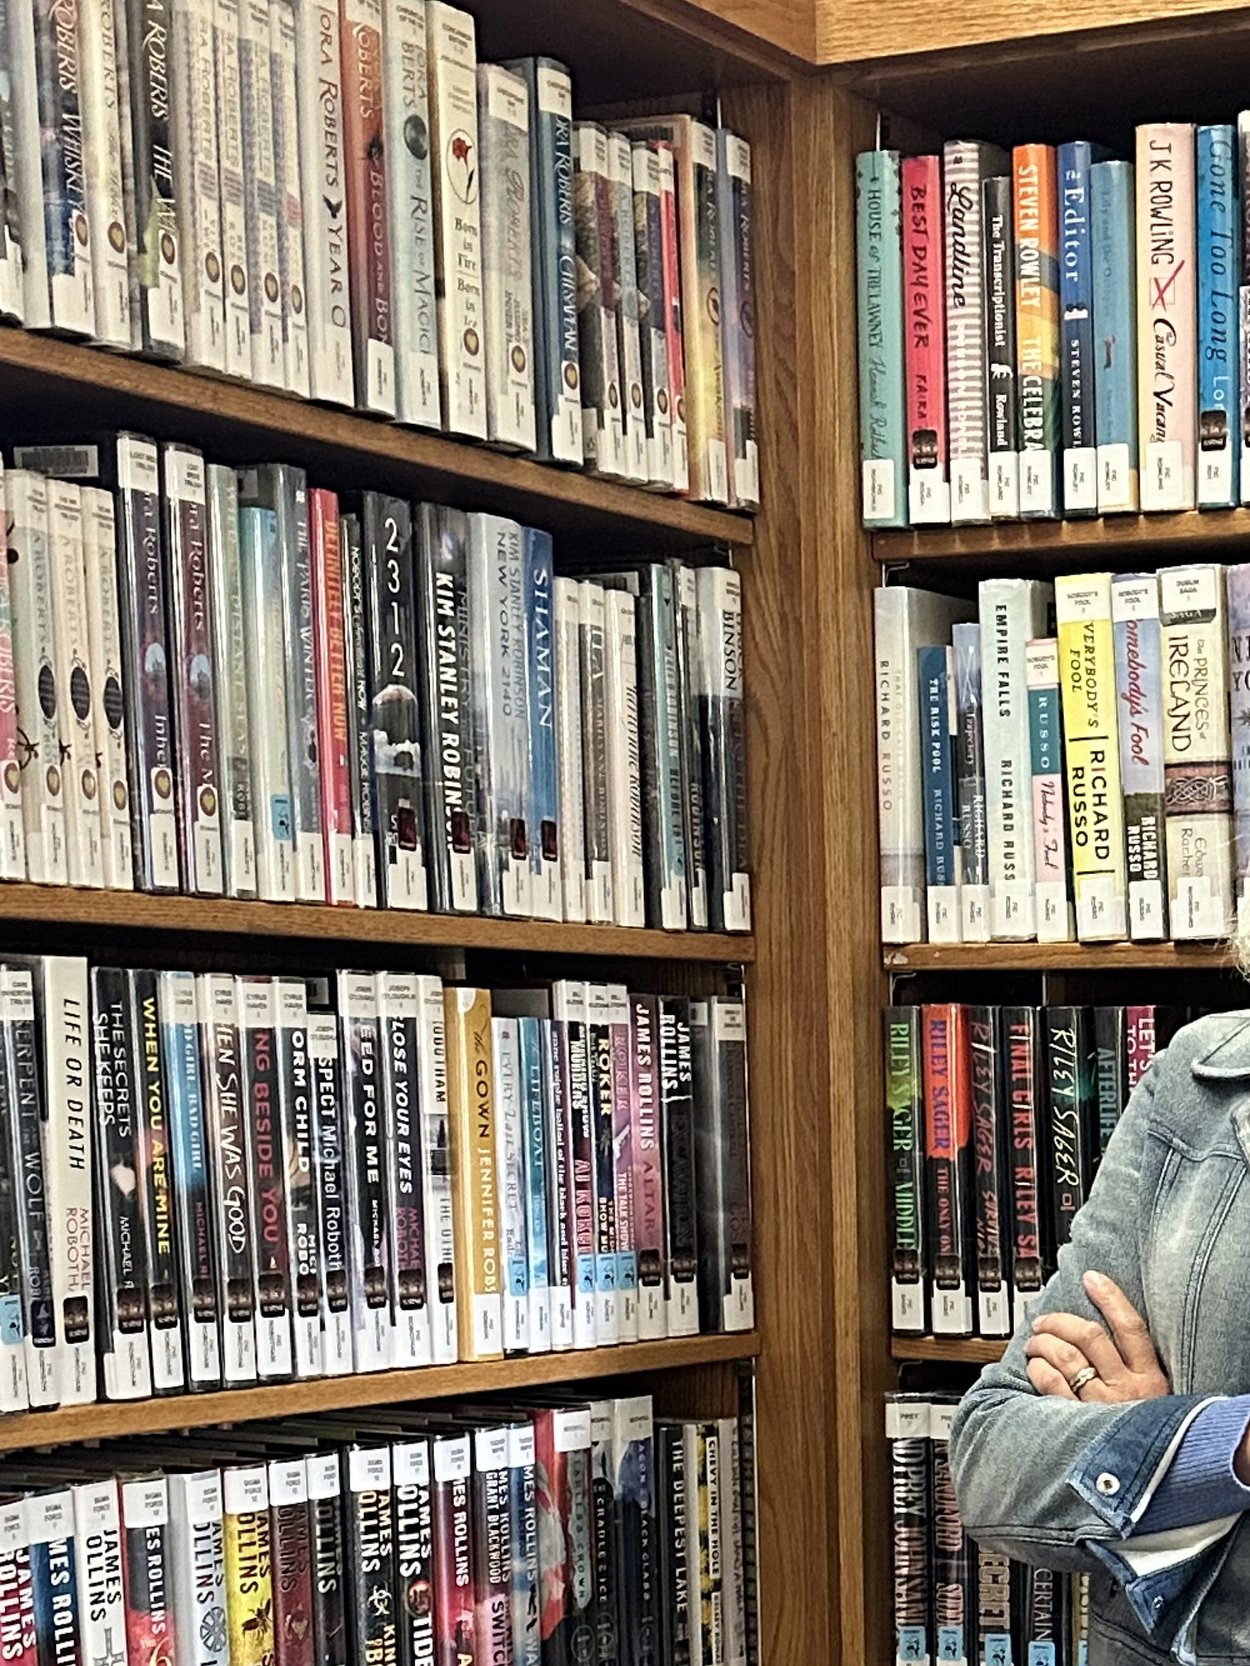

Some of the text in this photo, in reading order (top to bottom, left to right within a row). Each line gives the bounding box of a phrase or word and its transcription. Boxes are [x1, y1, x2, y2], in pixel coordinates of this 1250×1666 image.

[1150, 140, 1172, 152] J
[1151, 158, 1173, 175] K
[328, 225, 342, 294] YEAR
[867, 190, 883, 239] HOUSE
[912, 185, 930, 348] BEST DAY EVER
[948, 183, 973, 308] Landline
[1018, 165, 1040, 308] STEVEN ROWLEY
[1063, 186, 1084, 282] Editor
[1205, 143, 1234, 362] Gone Too Long
[867, 265, 884, 348] TRELAWNEY
[992, 215, 1006, 347] The Transcriptionist
[191, 542, 206, 630] Roberts
[497, 531, 512, 716] NEW YORK 2140
[995, 605, 1011, 718] EMPIRE FALLS
[1168, 635, 1190, 752] IRELAND
[1038, 697, 1050, 769] RUSSO
[1072, 767, 1089, 847] RUSSO
[1091, 750, 1110, 860] RICHARD
[64, 999, 85, 1170] LIFE OR DEATH
[141, 997, 169, 1254] WHEN YOU ARE MINE
[636, 1003, 654, 1150] JAMES ROLLINS
[929, 1020, 950, 1149] RILEY SAGER
[1010, 1025, 1032, 1149] FINAL GIRLS
[1050, 1028, 1078, 1187] RILEY SAGER
[1015, 1167, 1035, 1223] RILEY
[1033, 1569, 1053, 1641] CERTAIN
